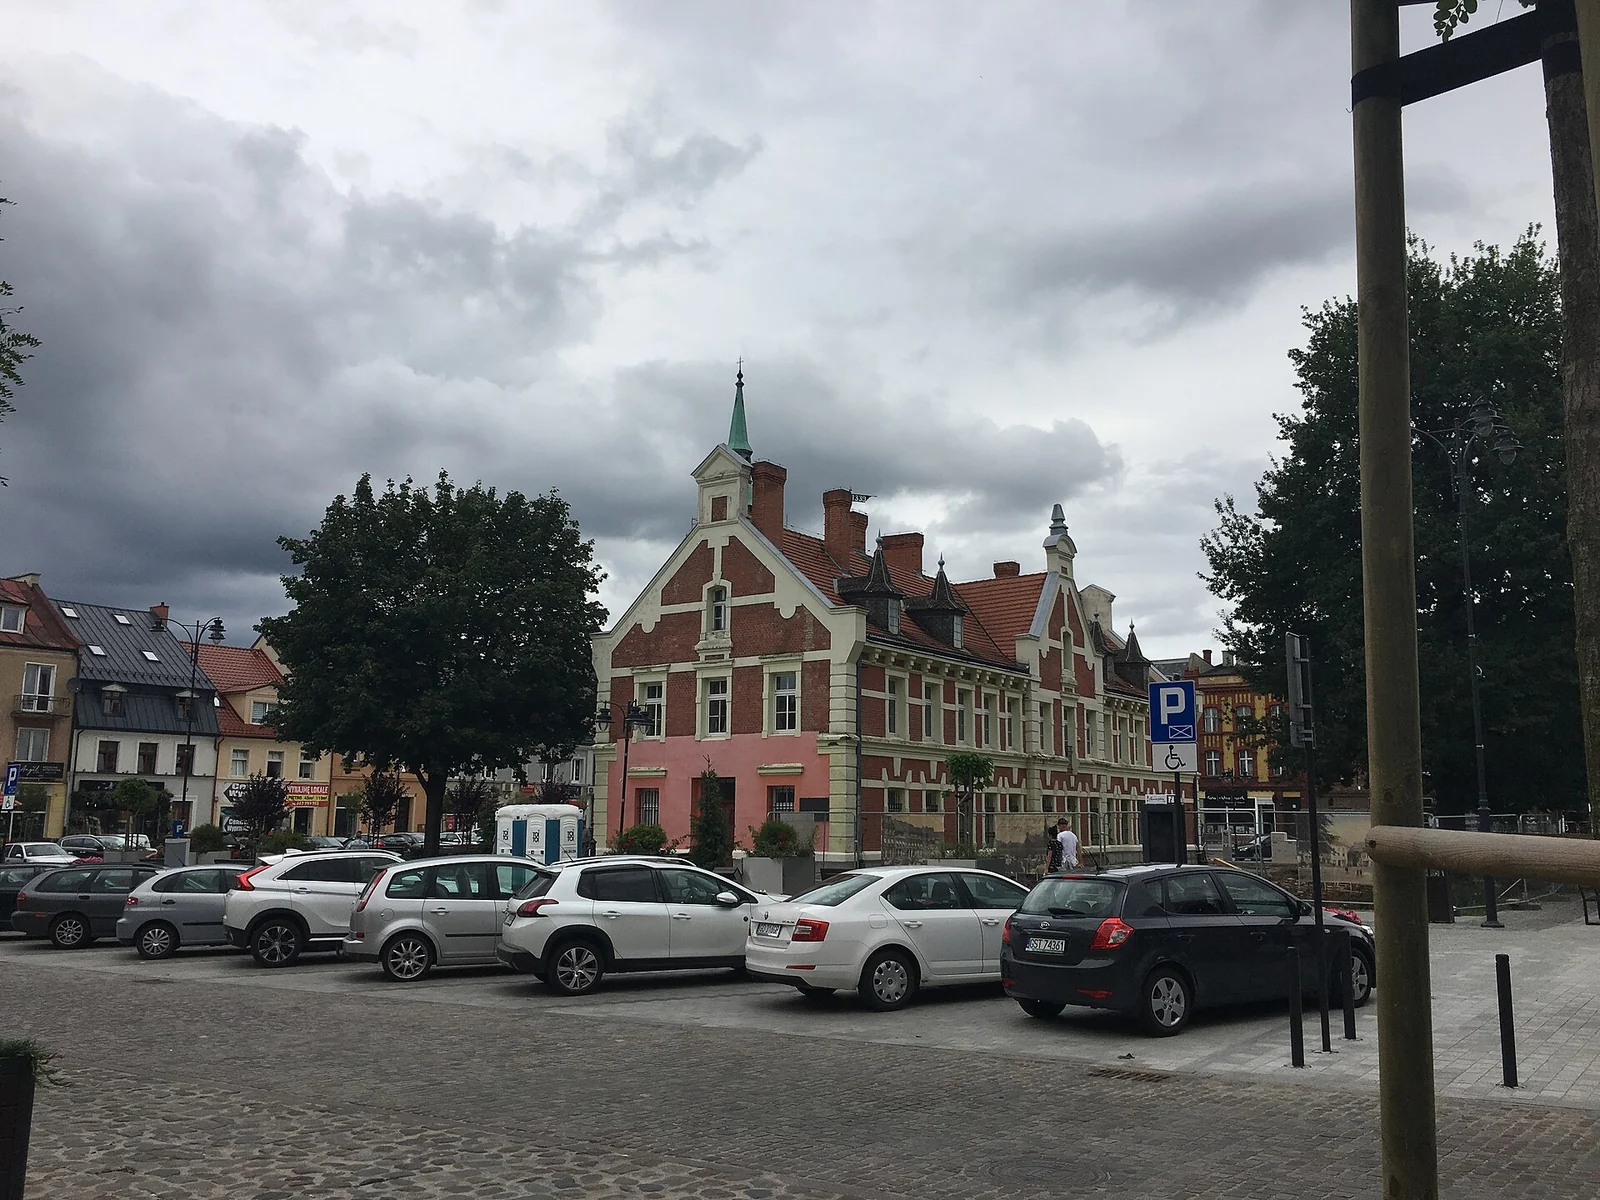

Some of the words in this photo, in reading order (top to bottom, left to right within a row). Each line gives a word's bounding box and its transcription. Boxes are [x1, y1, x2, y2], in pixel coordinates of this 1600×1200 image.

[1160, 687, 1185, 724] P
[8, 767, 17, 786] P
[176, 825, 183, 833] P
[1030, 938, 1042, 949] GST
[1043, 939, 1064, 951] 74361
